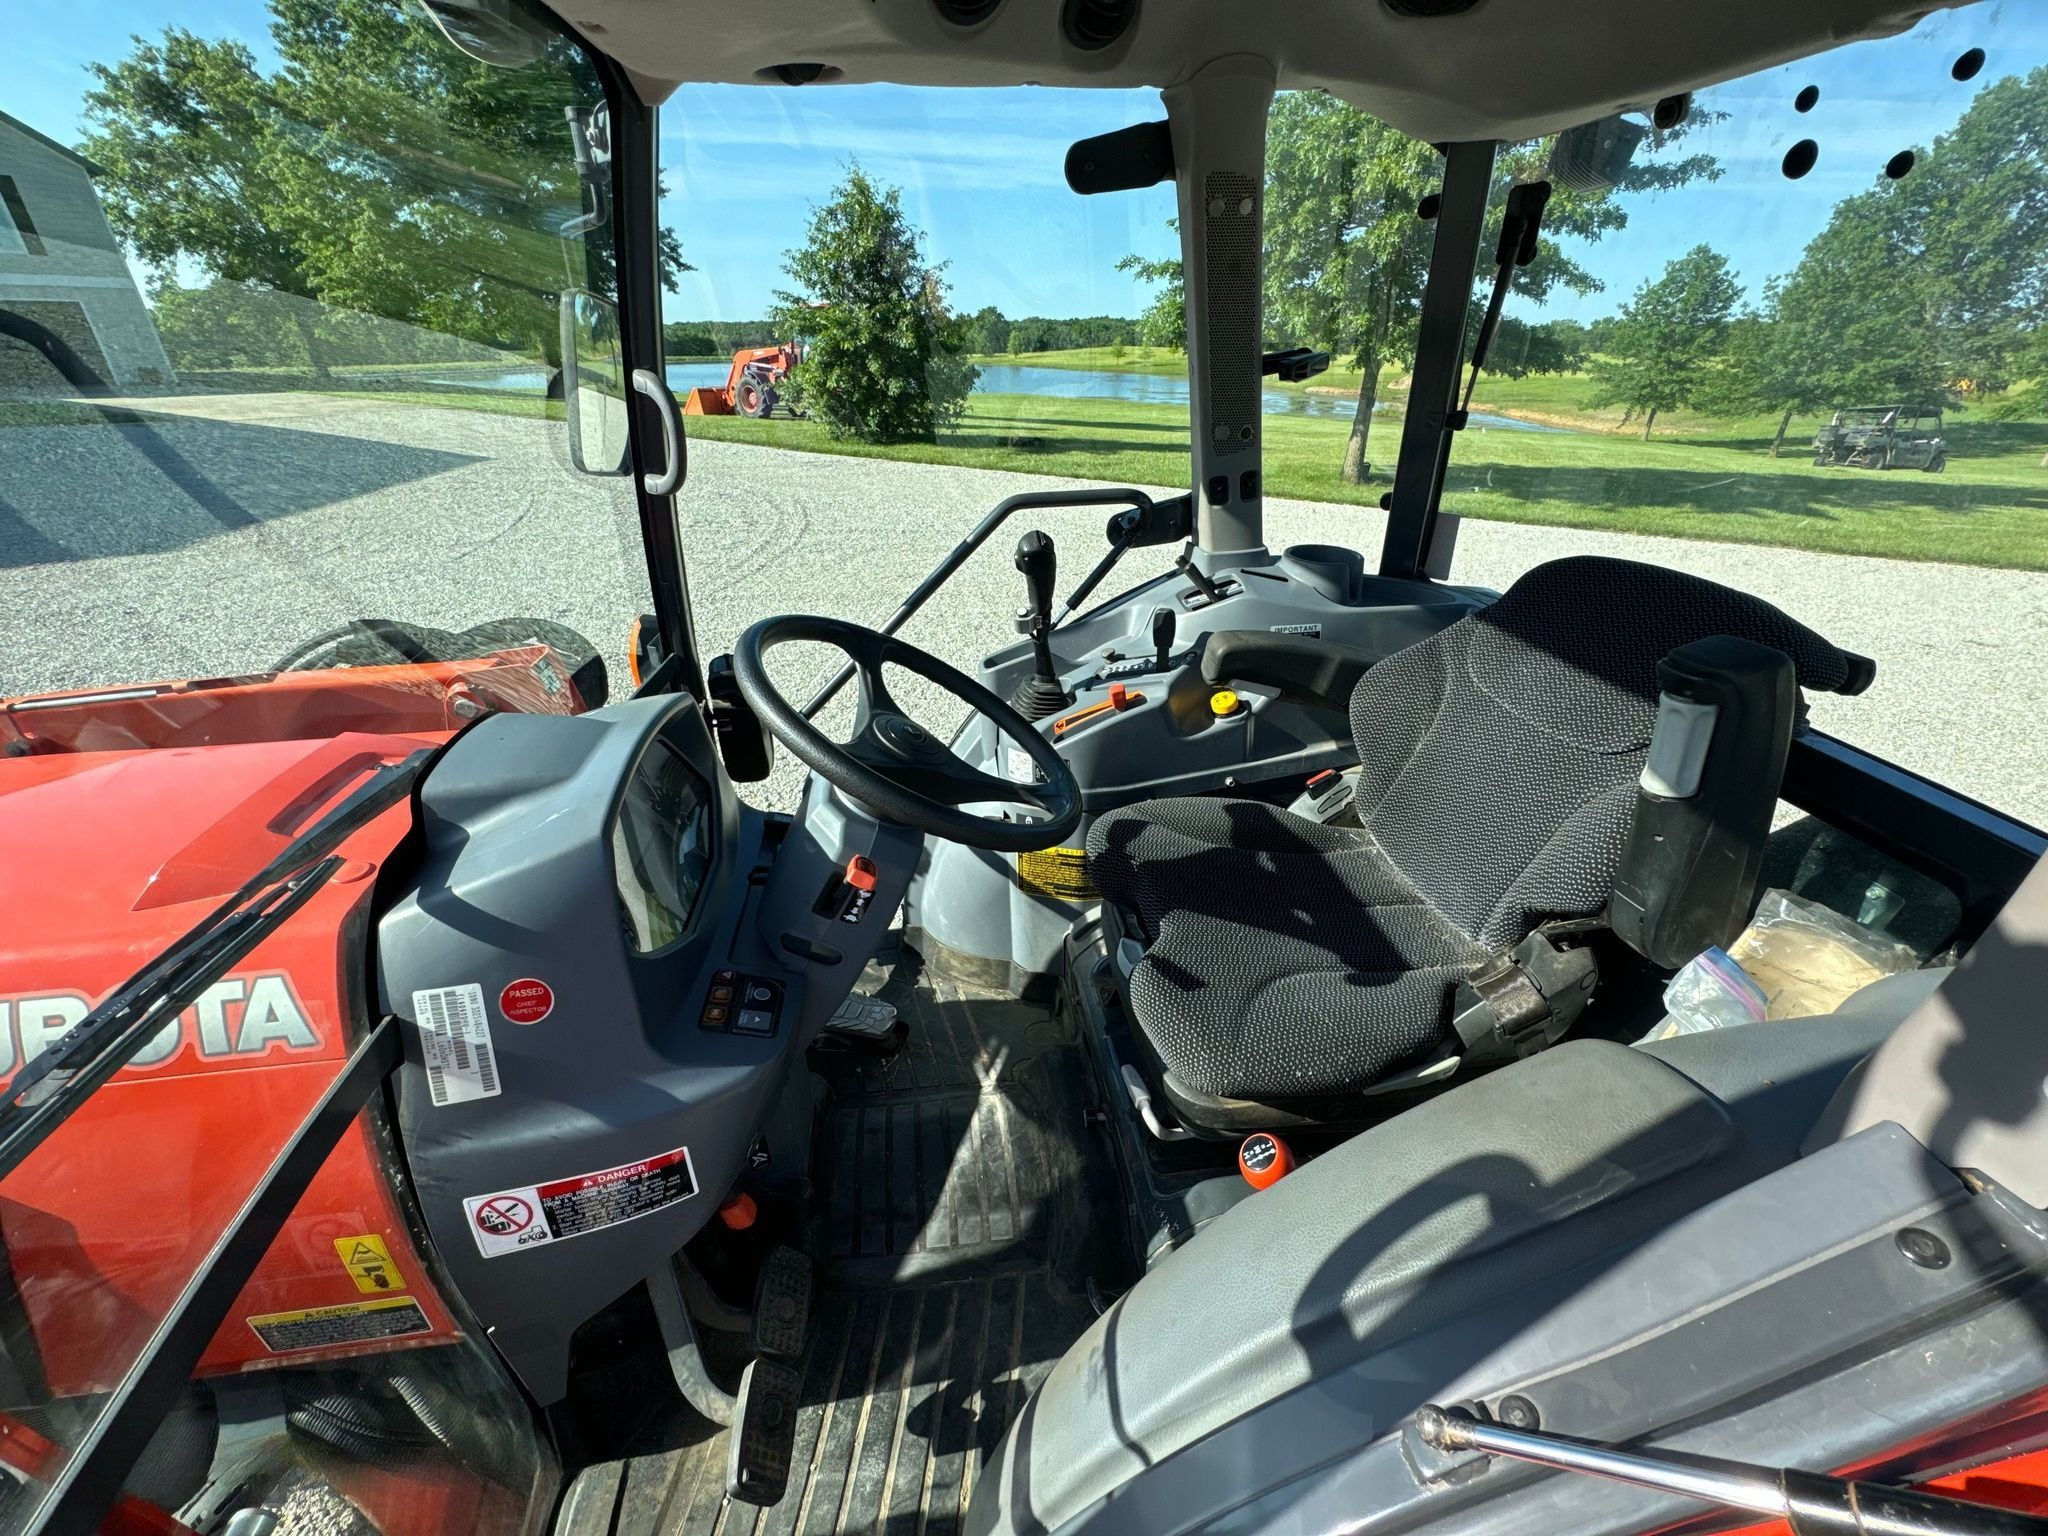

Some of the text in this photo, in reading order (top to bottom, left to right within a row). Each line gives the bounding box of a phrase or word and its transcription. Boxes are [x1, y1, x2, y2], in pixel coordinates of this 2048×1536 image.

[1274, 624, 1318, 633] IMPORTANT
[509, 987, 545, 998] PASSED
[508, 1005, 547, 1015] INSPECTOR
[597, 1164, 646, 1183] DANGER
[554, 1191, 573, 1200] AVOID
[575, 1183, 604, 1195] POSSIBLE
[606, 1178, 627, 1187] INJURY
[640, 1168, 661, 1178] DEATH
[544, 1199, 561, 1208] FROM
[571, 1189, 599, 1201] MACHINE
[600, 1182, 628, 1193] RUNAWAY
[315, 1305, 360, 1316] CAUTION
